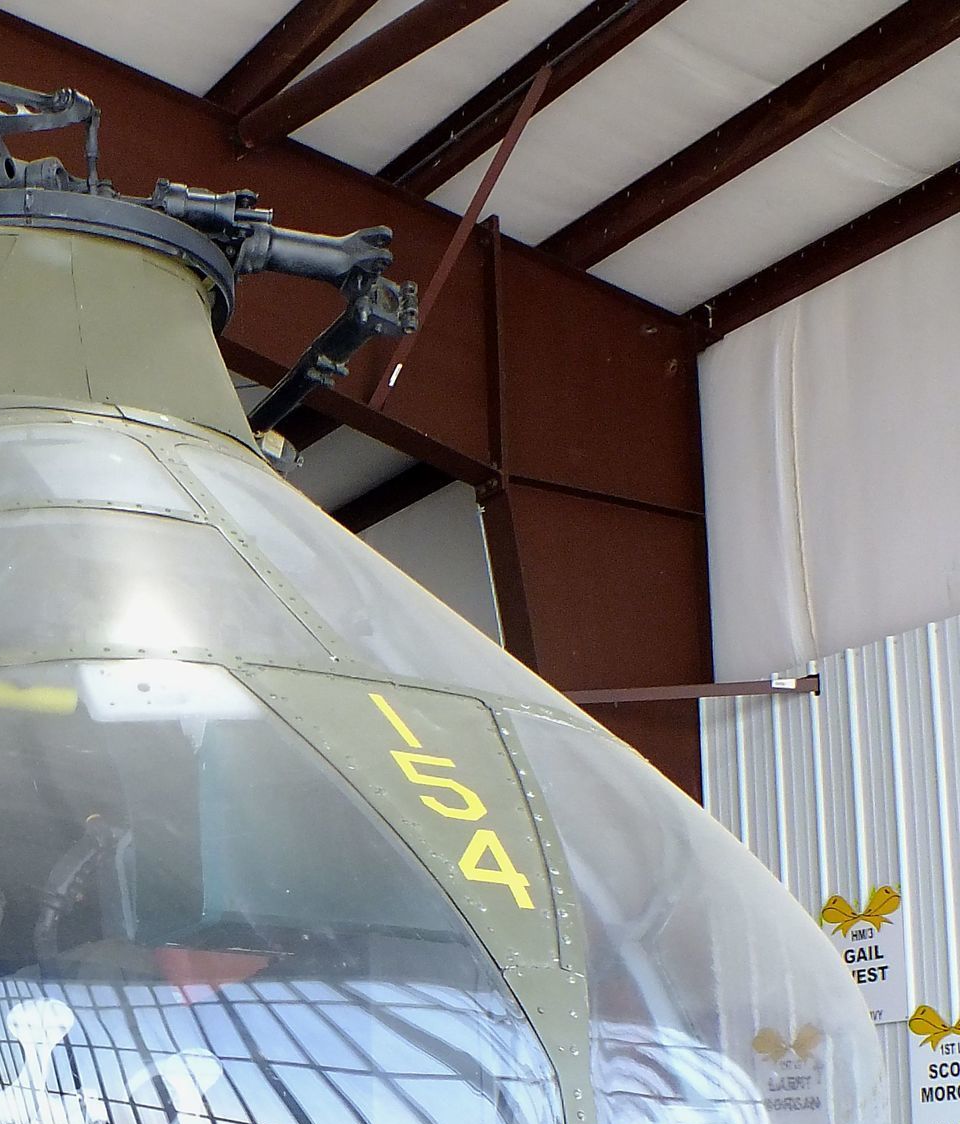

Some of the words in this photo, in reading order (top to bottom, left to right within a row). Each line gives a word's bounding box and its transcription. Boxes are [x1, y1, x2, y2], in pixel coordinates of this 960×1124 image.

[844, 945, 884, 964] GAIL
[852, 965, 888, 984] EST
[940, 1044, 955, 1056] 1ST
[921, 1085, 960, 1103] MOR
